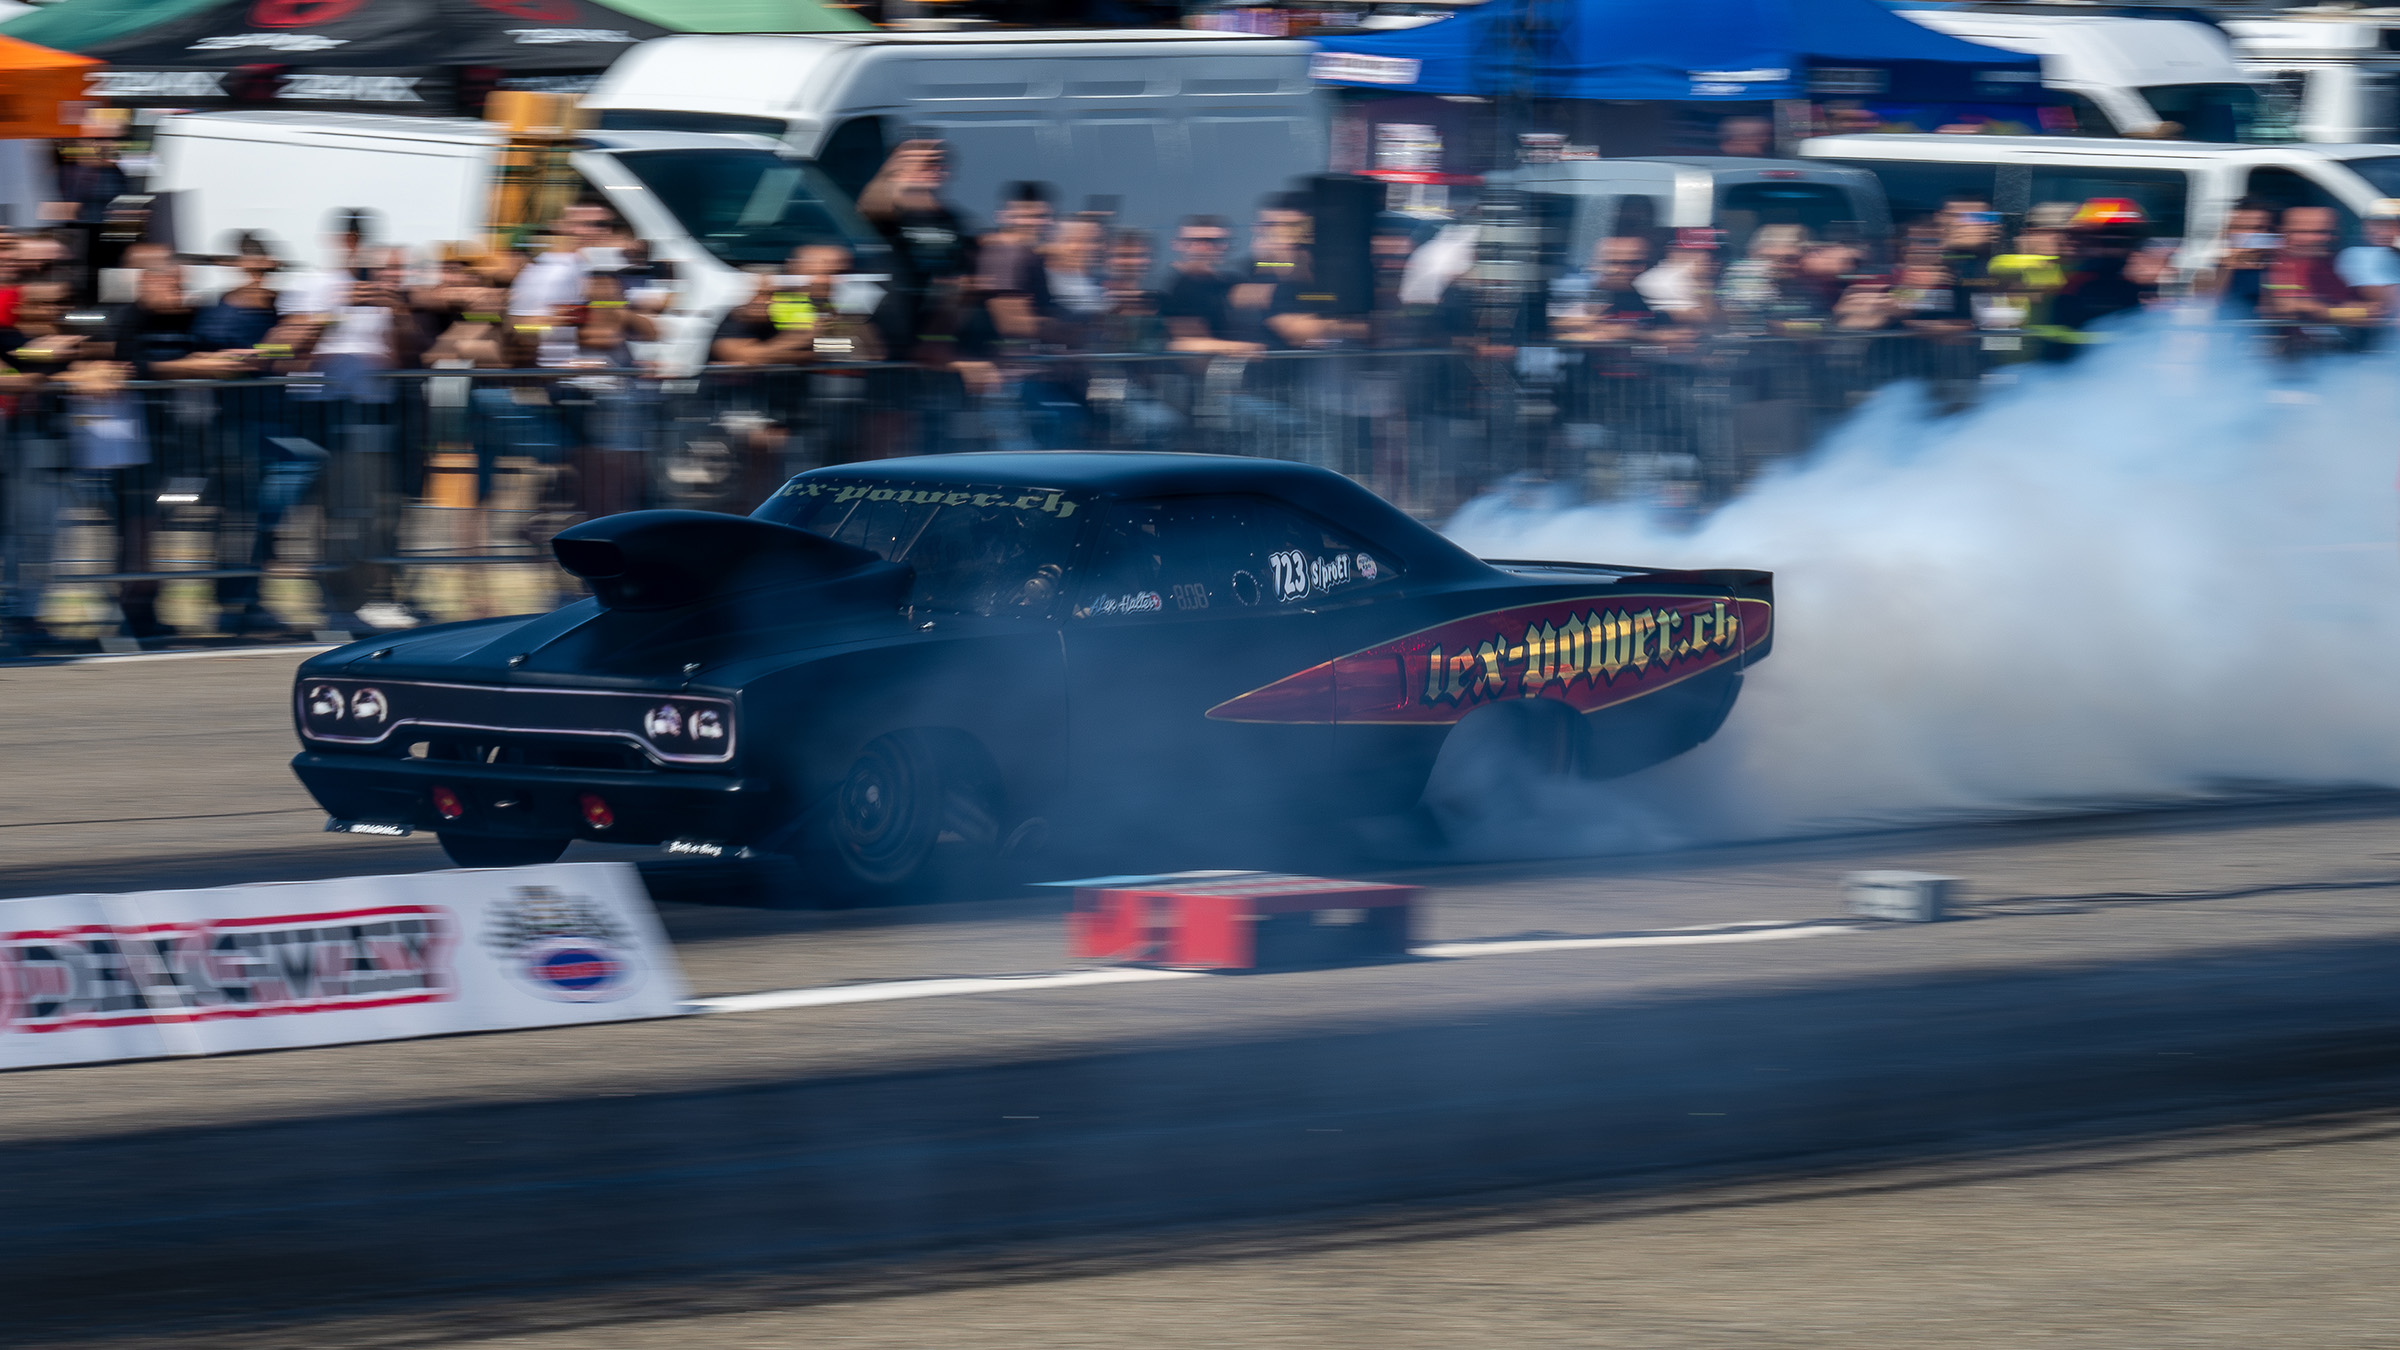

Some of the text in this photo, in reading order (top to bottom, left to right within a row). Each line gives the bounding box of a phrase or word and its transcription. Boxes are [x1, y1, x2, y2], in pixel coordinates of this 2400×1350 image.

[775, 482, 1081, 519] ex-power.ch
[1269, 550, 1308, 600] 723
[1424, 602, 1738, 706] lex-power.ch
